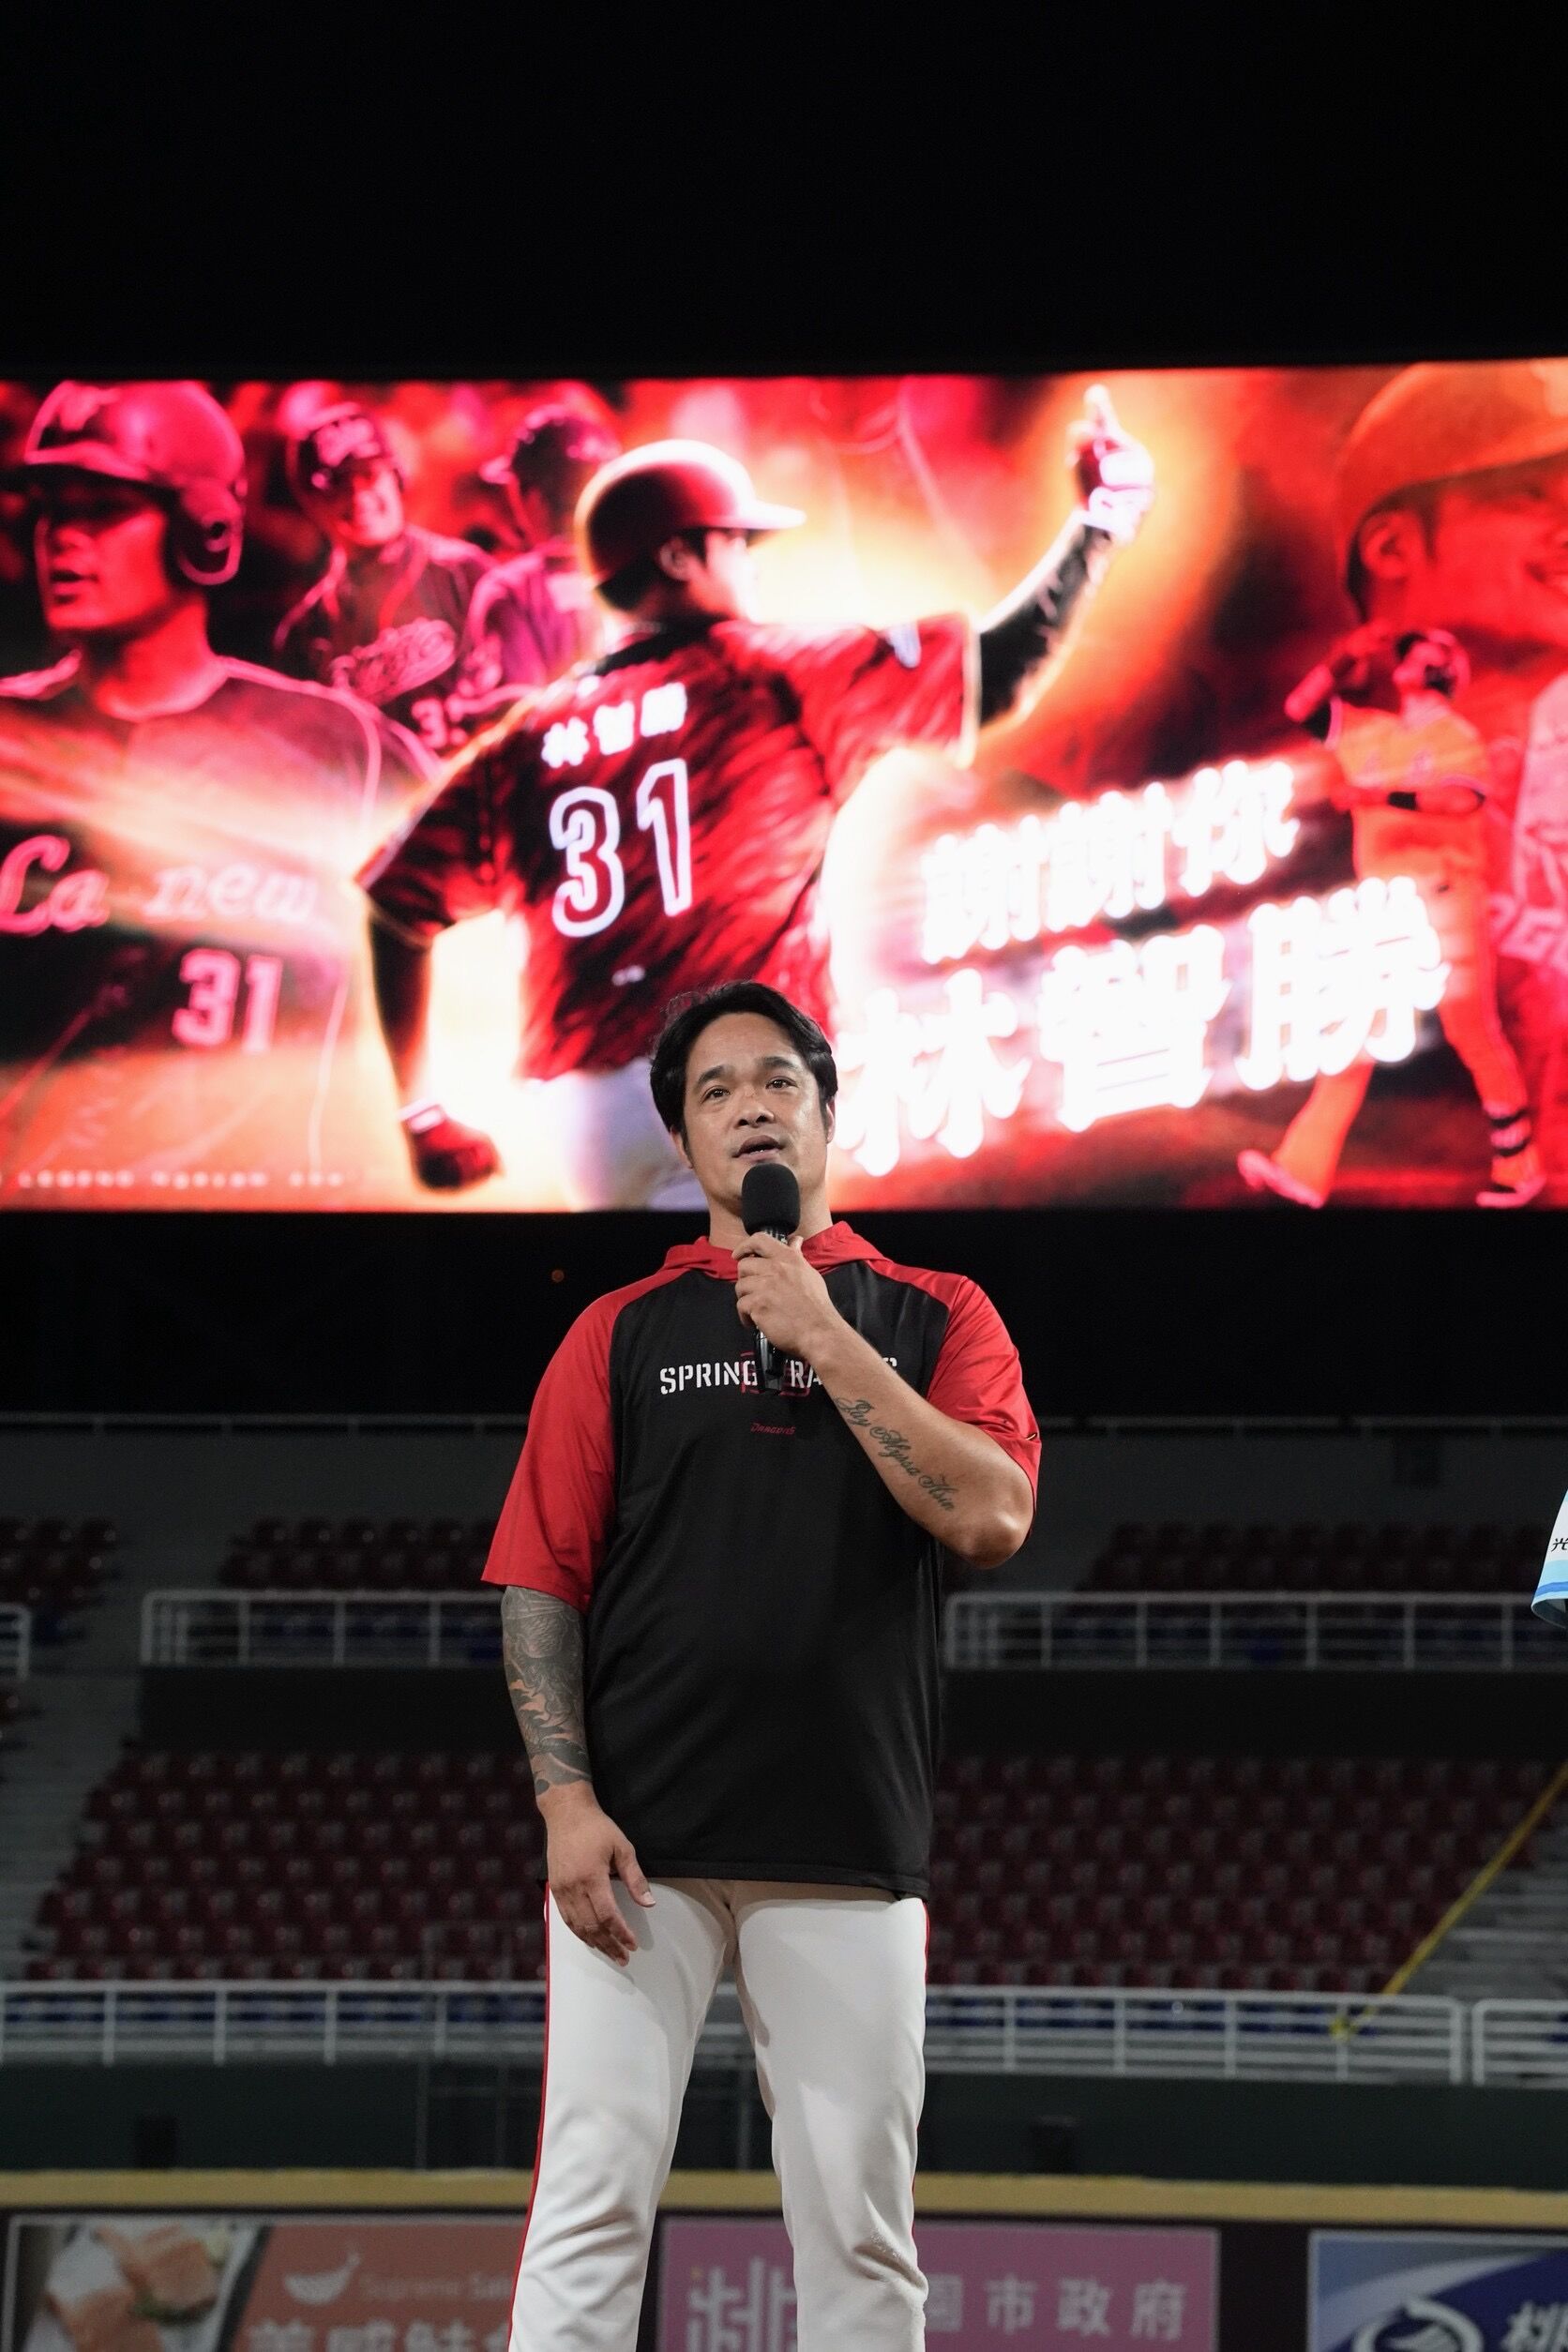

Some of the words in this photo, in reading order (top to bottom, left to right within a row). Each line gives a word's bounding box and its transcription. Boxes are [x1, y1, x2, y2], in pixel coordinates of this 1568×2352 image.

[0, 835, 111, 936] La
[143, 863, 319, 924] new
[550, 757, 692, 938] 31
[920, 760, 1301, 964] 謝謝你
[171, 947, 283, 1056] 31
[830, 874, 1451, 1177] 林智勝
[659, 1359, 759, 1395] SPRING
